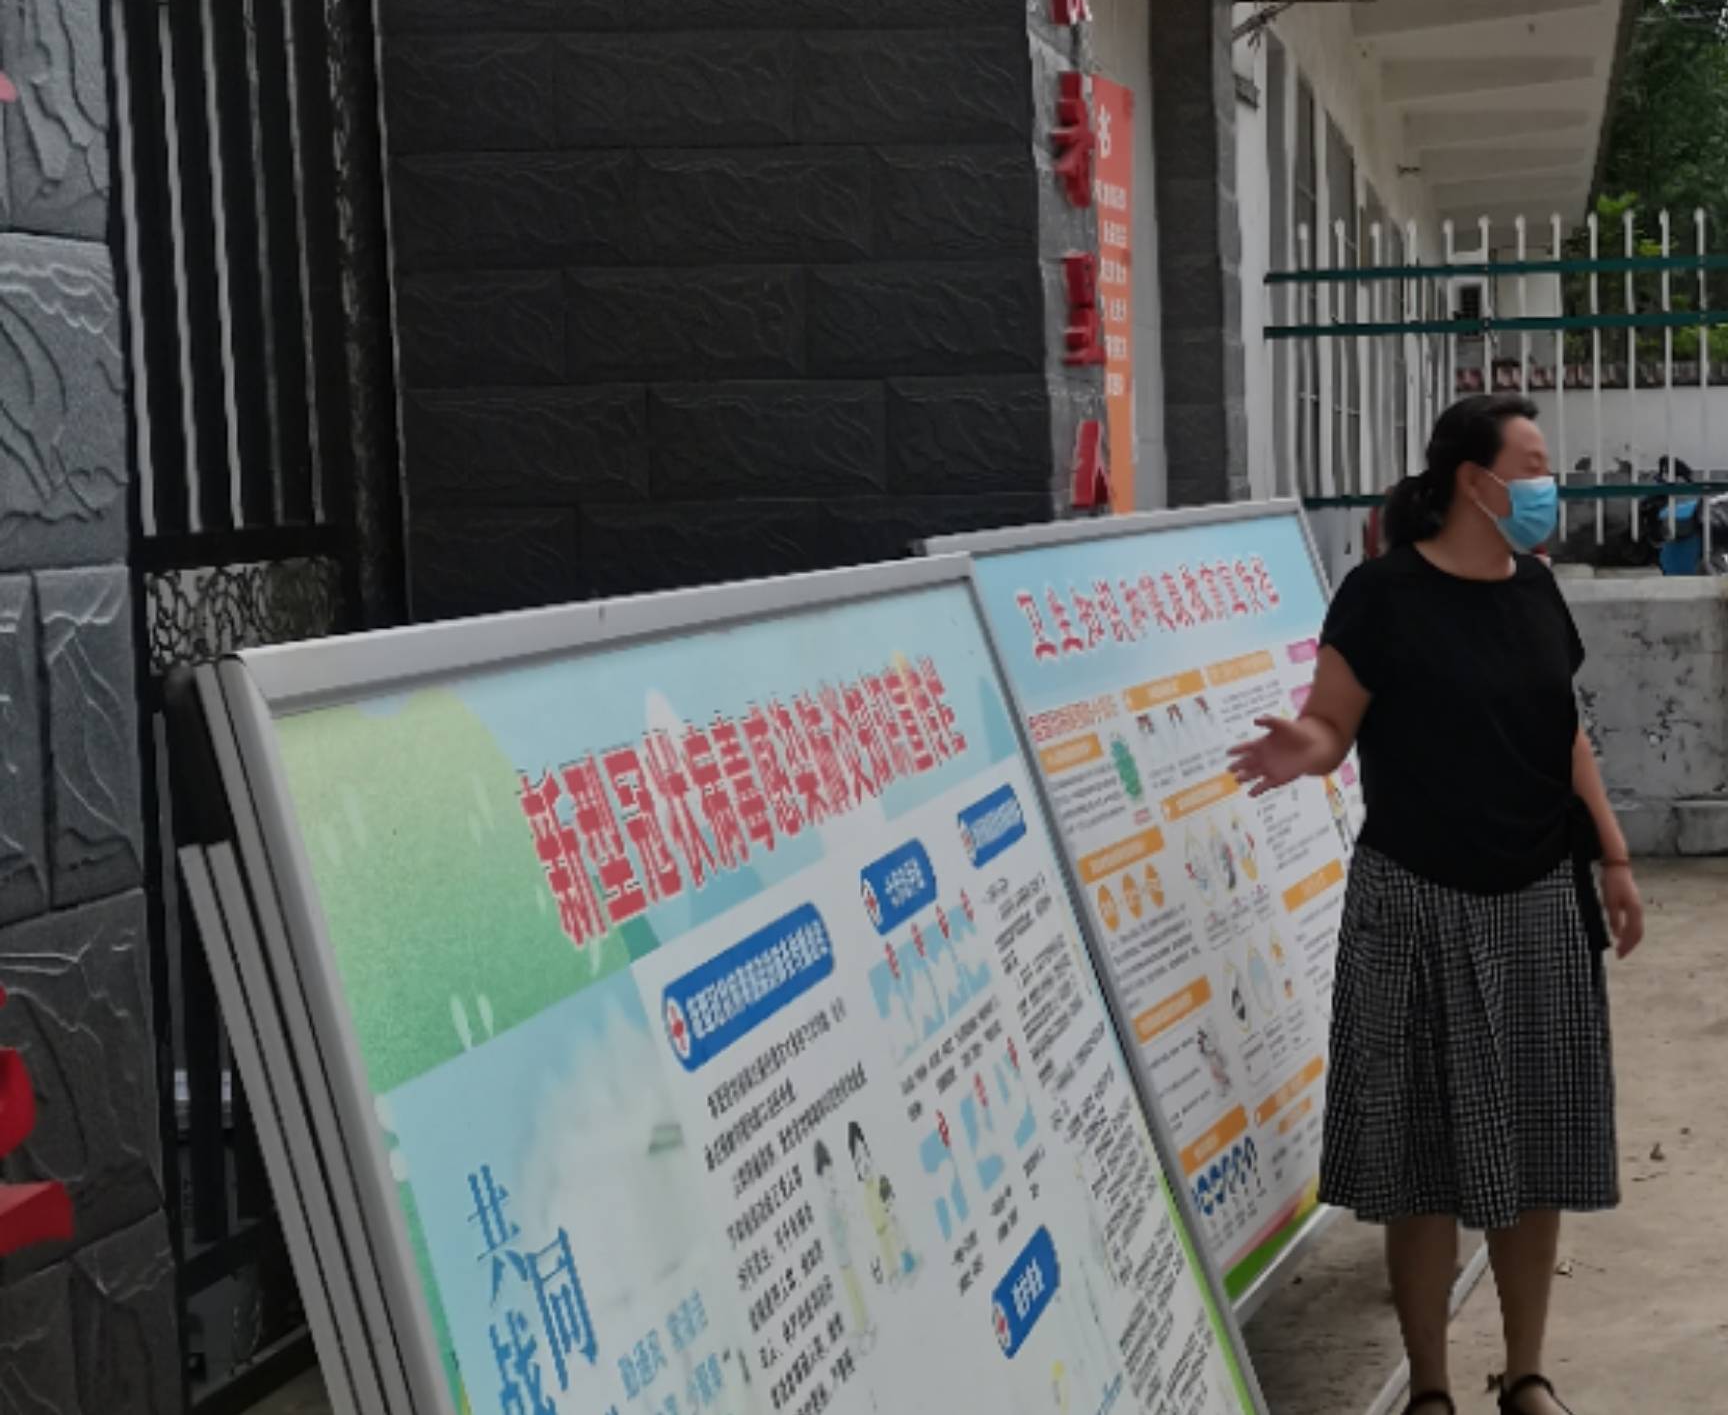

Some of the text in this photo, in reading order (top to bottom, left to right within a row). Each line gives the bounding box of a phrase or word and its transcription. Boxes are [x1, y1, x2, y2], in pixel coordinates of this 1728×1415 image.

[519, 656, 967, 946] 新型冠状病毒感染肺炎知识宣传栏
